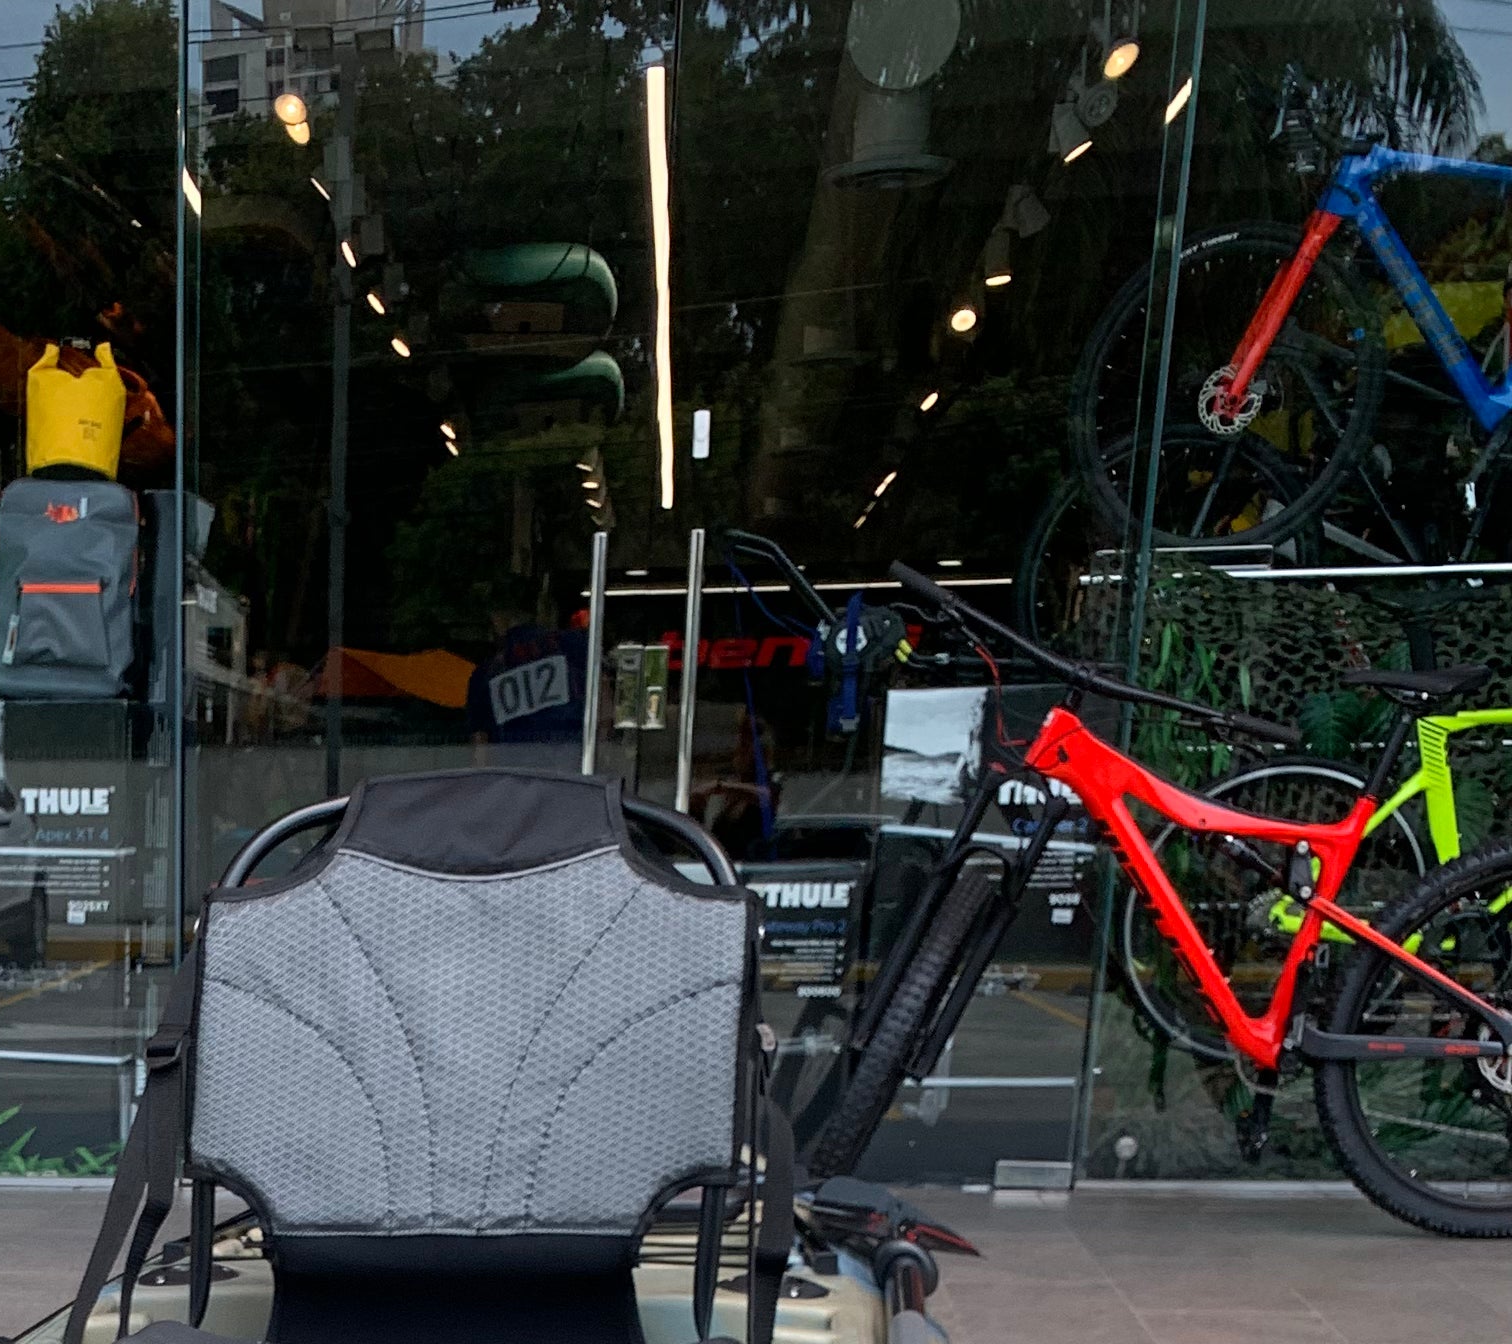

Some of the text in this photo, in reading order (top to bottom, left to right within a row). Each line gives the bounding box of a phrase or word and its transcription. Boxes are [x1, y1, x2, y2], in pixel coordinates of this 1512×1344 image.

[498, 663, 562, 714] 012
[20, 786, 109, 815] THULE
[761, 882, 850, 908] THULE
